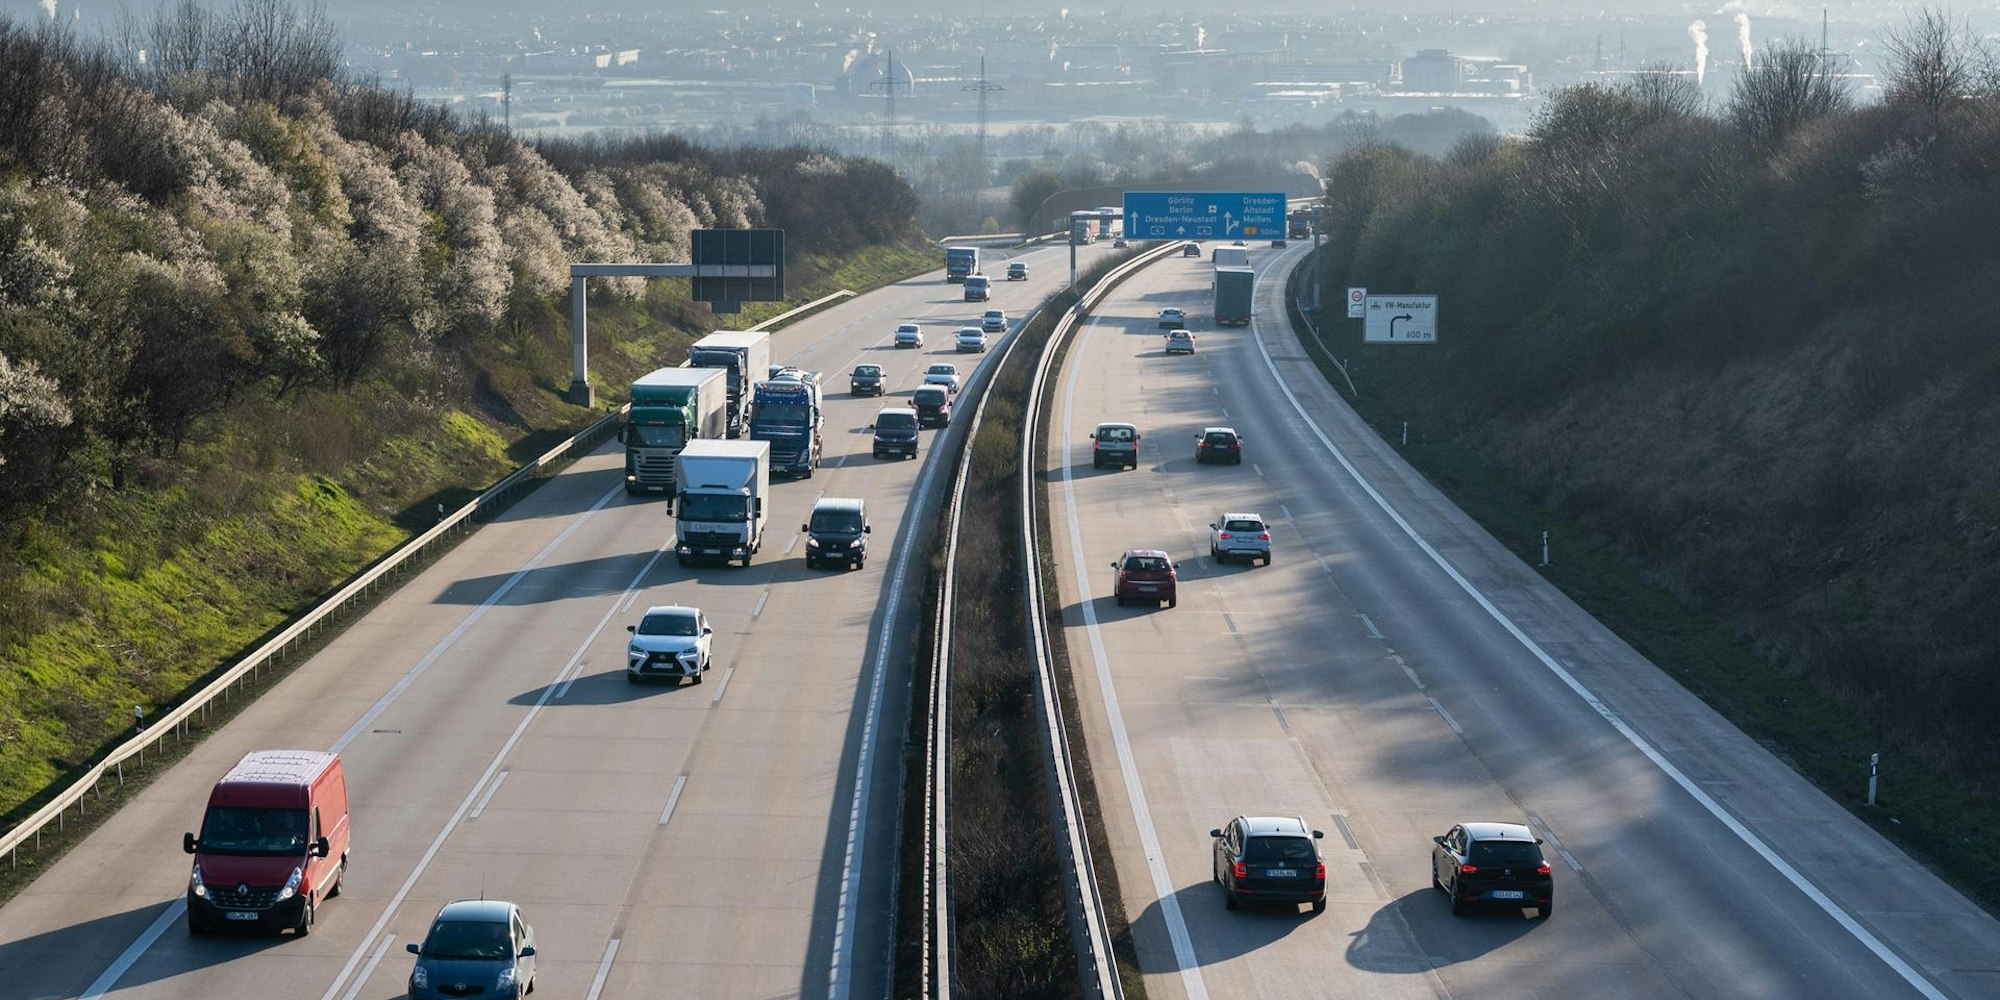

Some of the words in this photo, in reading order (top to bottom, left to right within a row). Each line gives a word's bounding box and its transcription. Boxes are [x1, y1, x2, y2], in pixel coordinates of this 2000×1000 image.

[1168, 196, 1194, 205] Görlitz
[1243, 197, 1280, 205] Dresden-
[1169, 206, 1193, 214] Berlin
[1244, 206, 1274, 214] Altstadt
[1145, 215, 1217, 223] Dresden-Neustadt
[1243, 215, 1271, 223] Meißen
